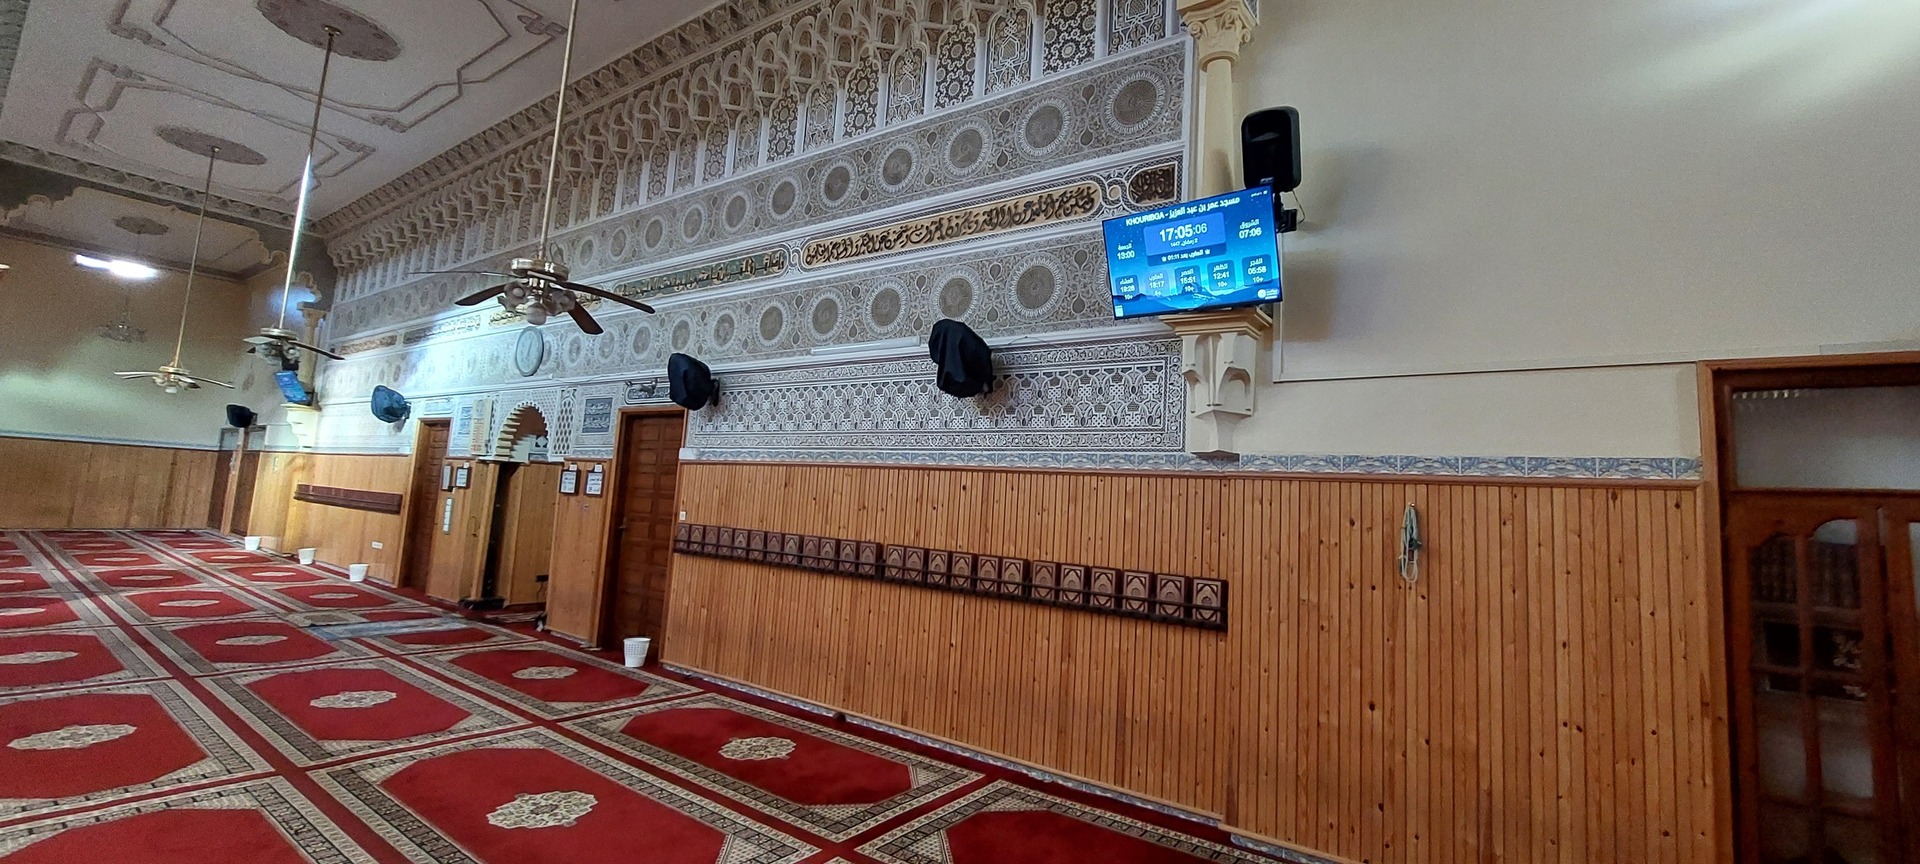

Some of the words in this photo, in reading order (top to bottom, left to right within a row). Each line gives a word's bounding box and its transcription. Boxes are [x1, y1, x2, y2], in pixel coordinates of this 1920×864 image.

[1207, 200, 1219, 211] عمر
[1219, 197, 1241, 208] مسجد
[1169, 206, 1186, 220] العزيز
[1186, 205, 1198, 215] عبد
[1126, 212, 1165, 227] KHOURIBGA
[1159, 222, 1208, 242] 17:05:06
[1117, 250, 1135, 260] 13:00
[1213, 271, 1230, 280] 12:41
